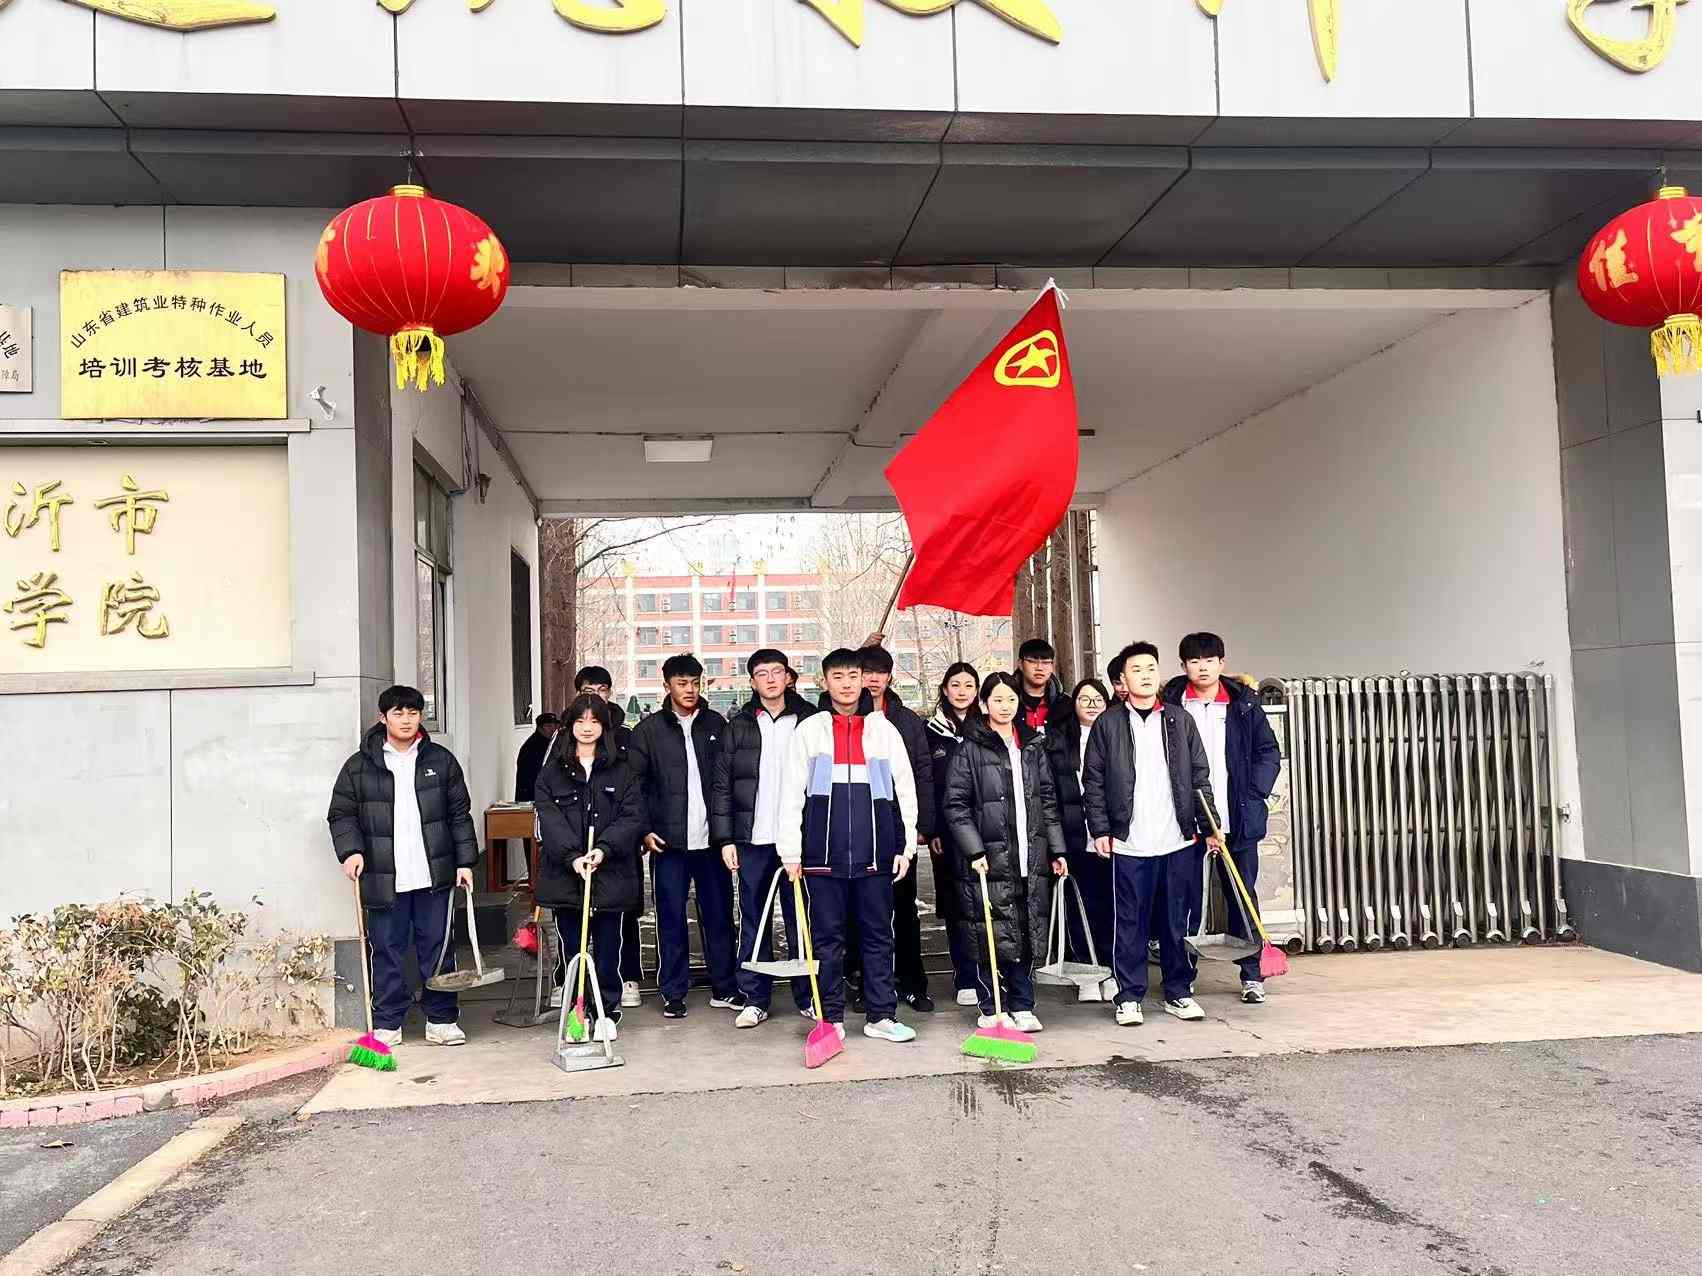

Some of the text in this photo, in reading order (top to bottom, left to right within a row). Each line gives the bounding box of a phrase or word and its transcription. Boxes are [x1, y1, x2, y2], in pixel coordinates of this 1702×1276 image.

[70, 295, 274, 348] 山东省建筑业特种作业人员
[79, 356, 267, 378] 培训考核基地
[4, 474, 169, 555] 沂市
[3, 571, 169, 649] 学院
